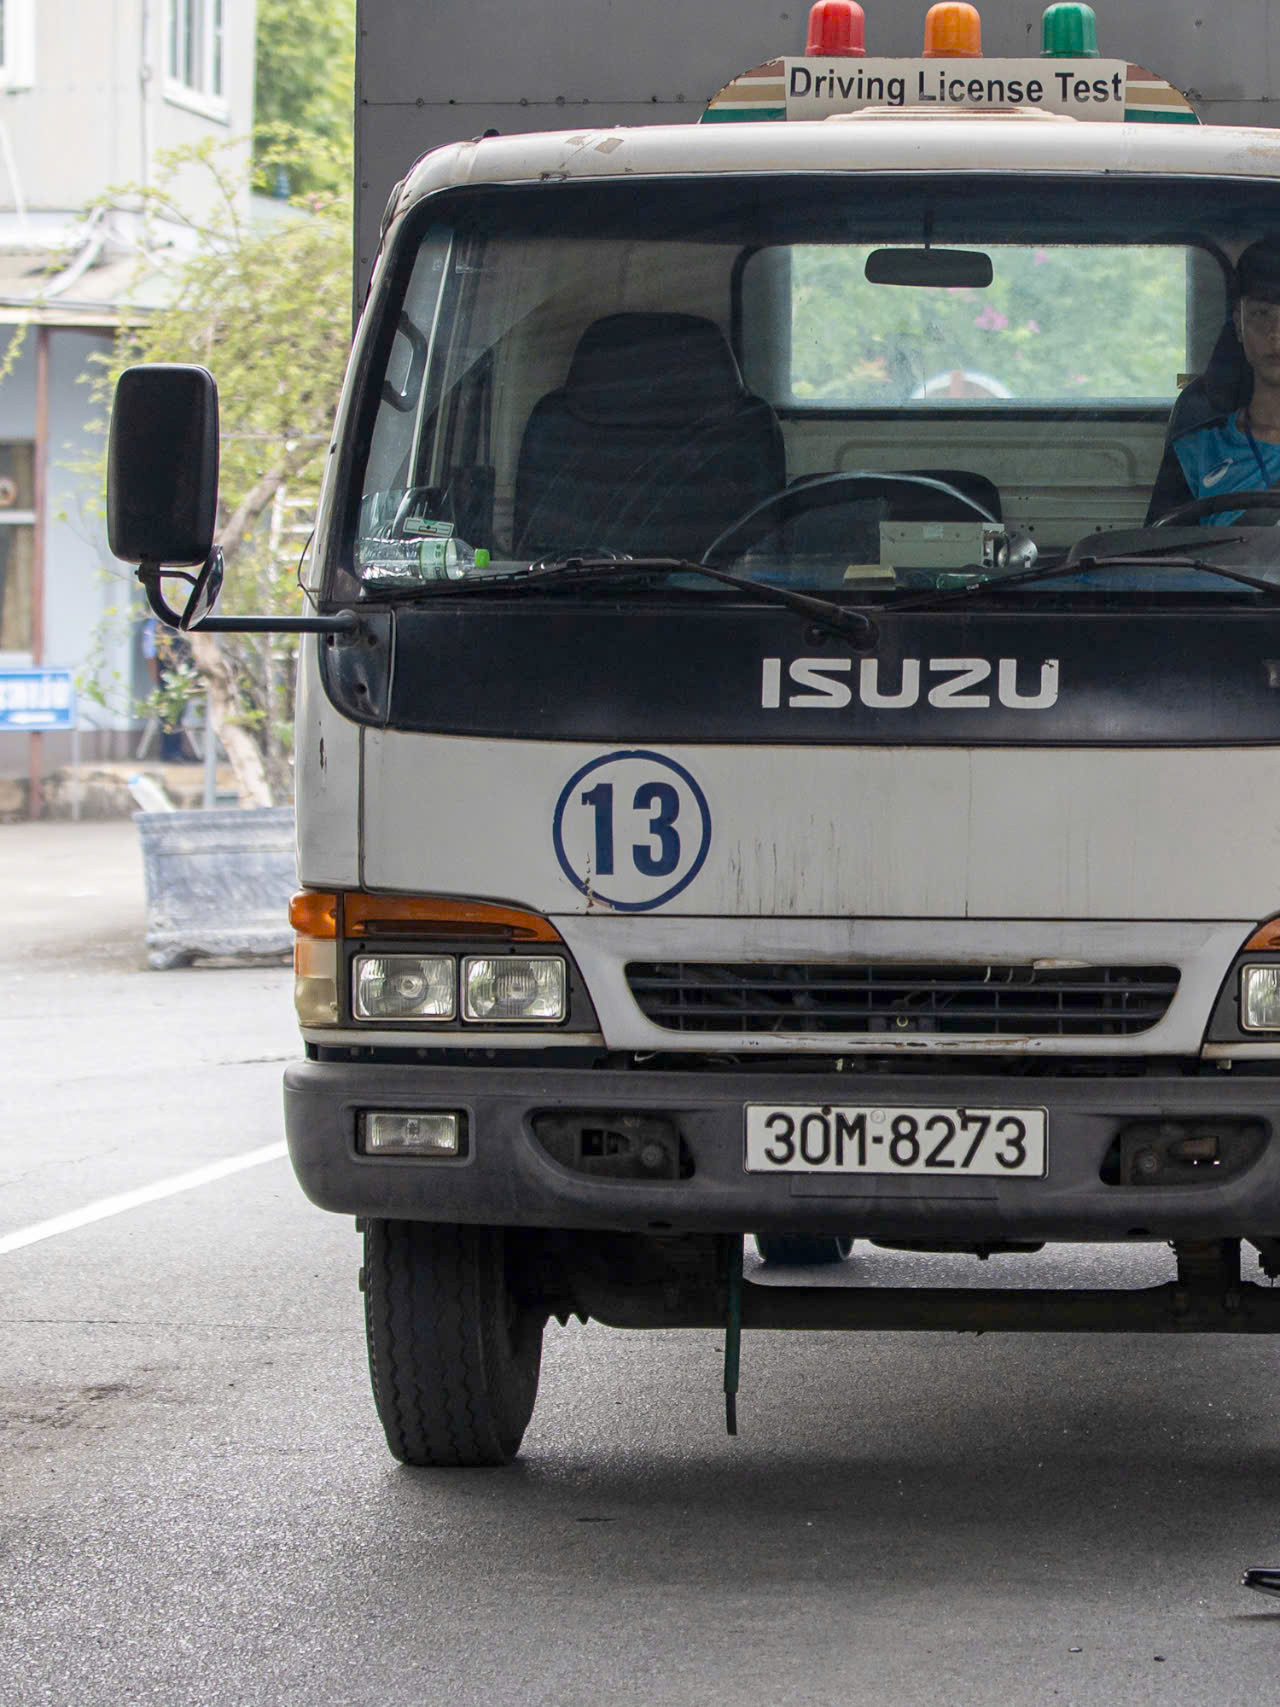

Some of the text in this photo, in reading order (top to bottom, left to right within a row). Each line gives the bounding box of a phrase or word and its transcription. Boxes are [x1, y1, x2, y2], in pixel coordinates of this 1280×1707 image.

[790, 66, 1123, 107] Driving License Test
[761, 657, 1059, 709] ISUZU
[581, 781, 681, 877] 13
[764, 1111, 1027, 1170] 30M-8273
